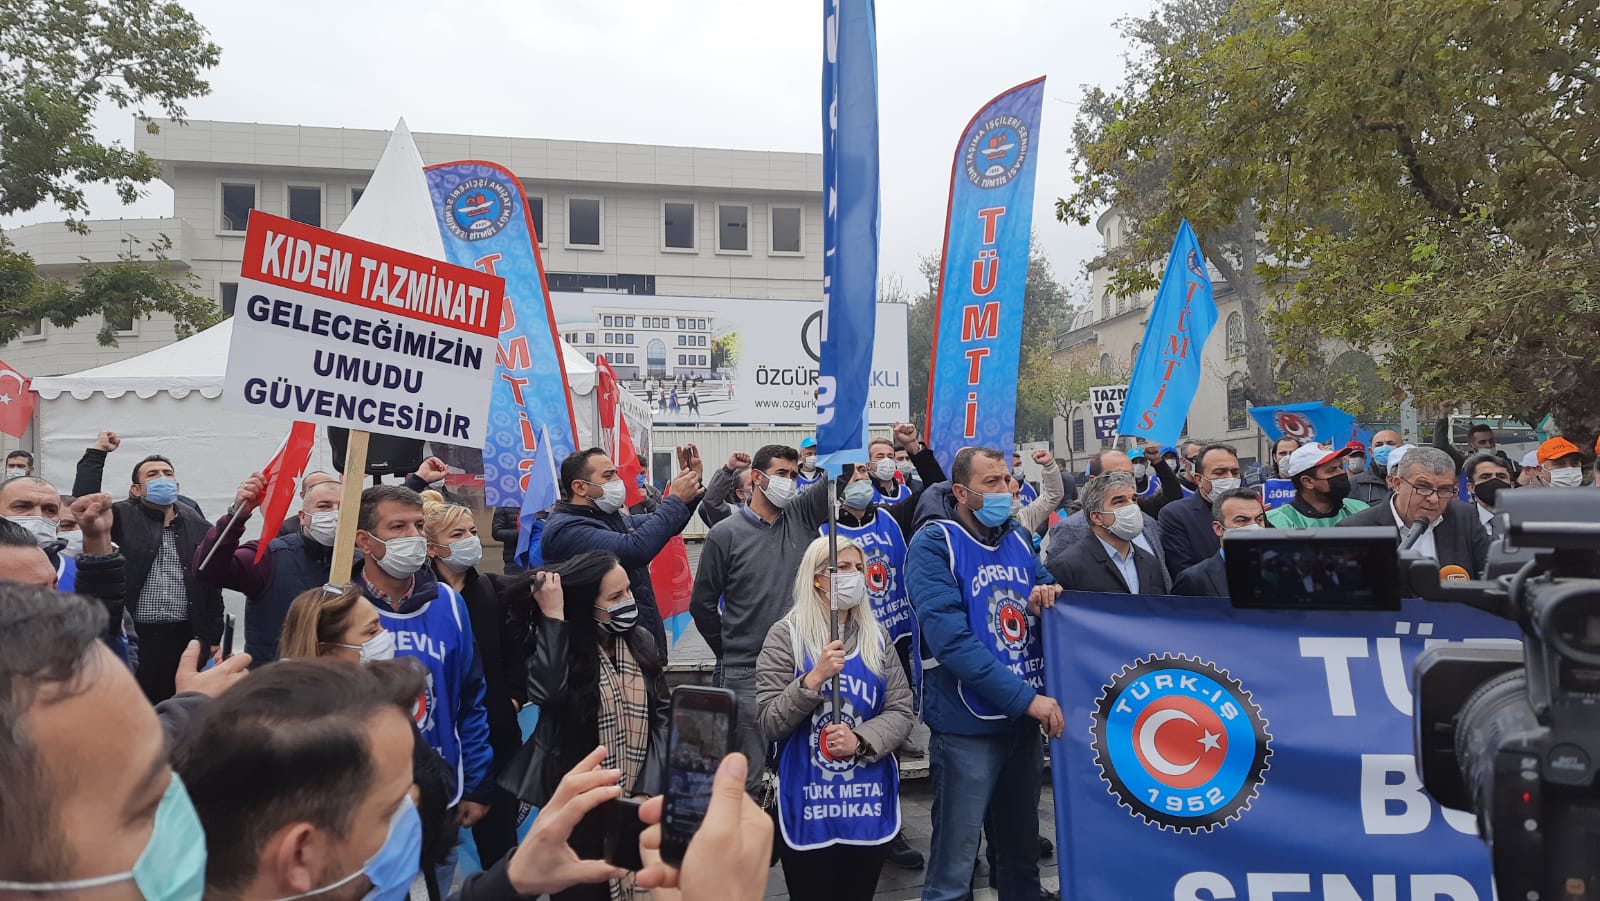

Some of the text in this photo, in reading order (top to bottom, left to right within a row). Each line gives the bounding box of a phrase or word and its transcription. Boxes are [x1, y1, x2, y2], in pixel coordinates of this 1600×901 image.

[260, 230, 490, 328] KIDEM TAZMİNATI
[247, 294, 483, 370] GELECEĞİMİZİN
[313, 350, 424, 393] UMUDU
[756, 365, 819, 386] ÖZGÜR
[243, 377, 471, 440] GÜVENCESİDİR
[1268, 488, 1298, 499] GÖRE
[803, 782, 835, 801] TÜRK
[1147, 787, 1225, 812] 1952
